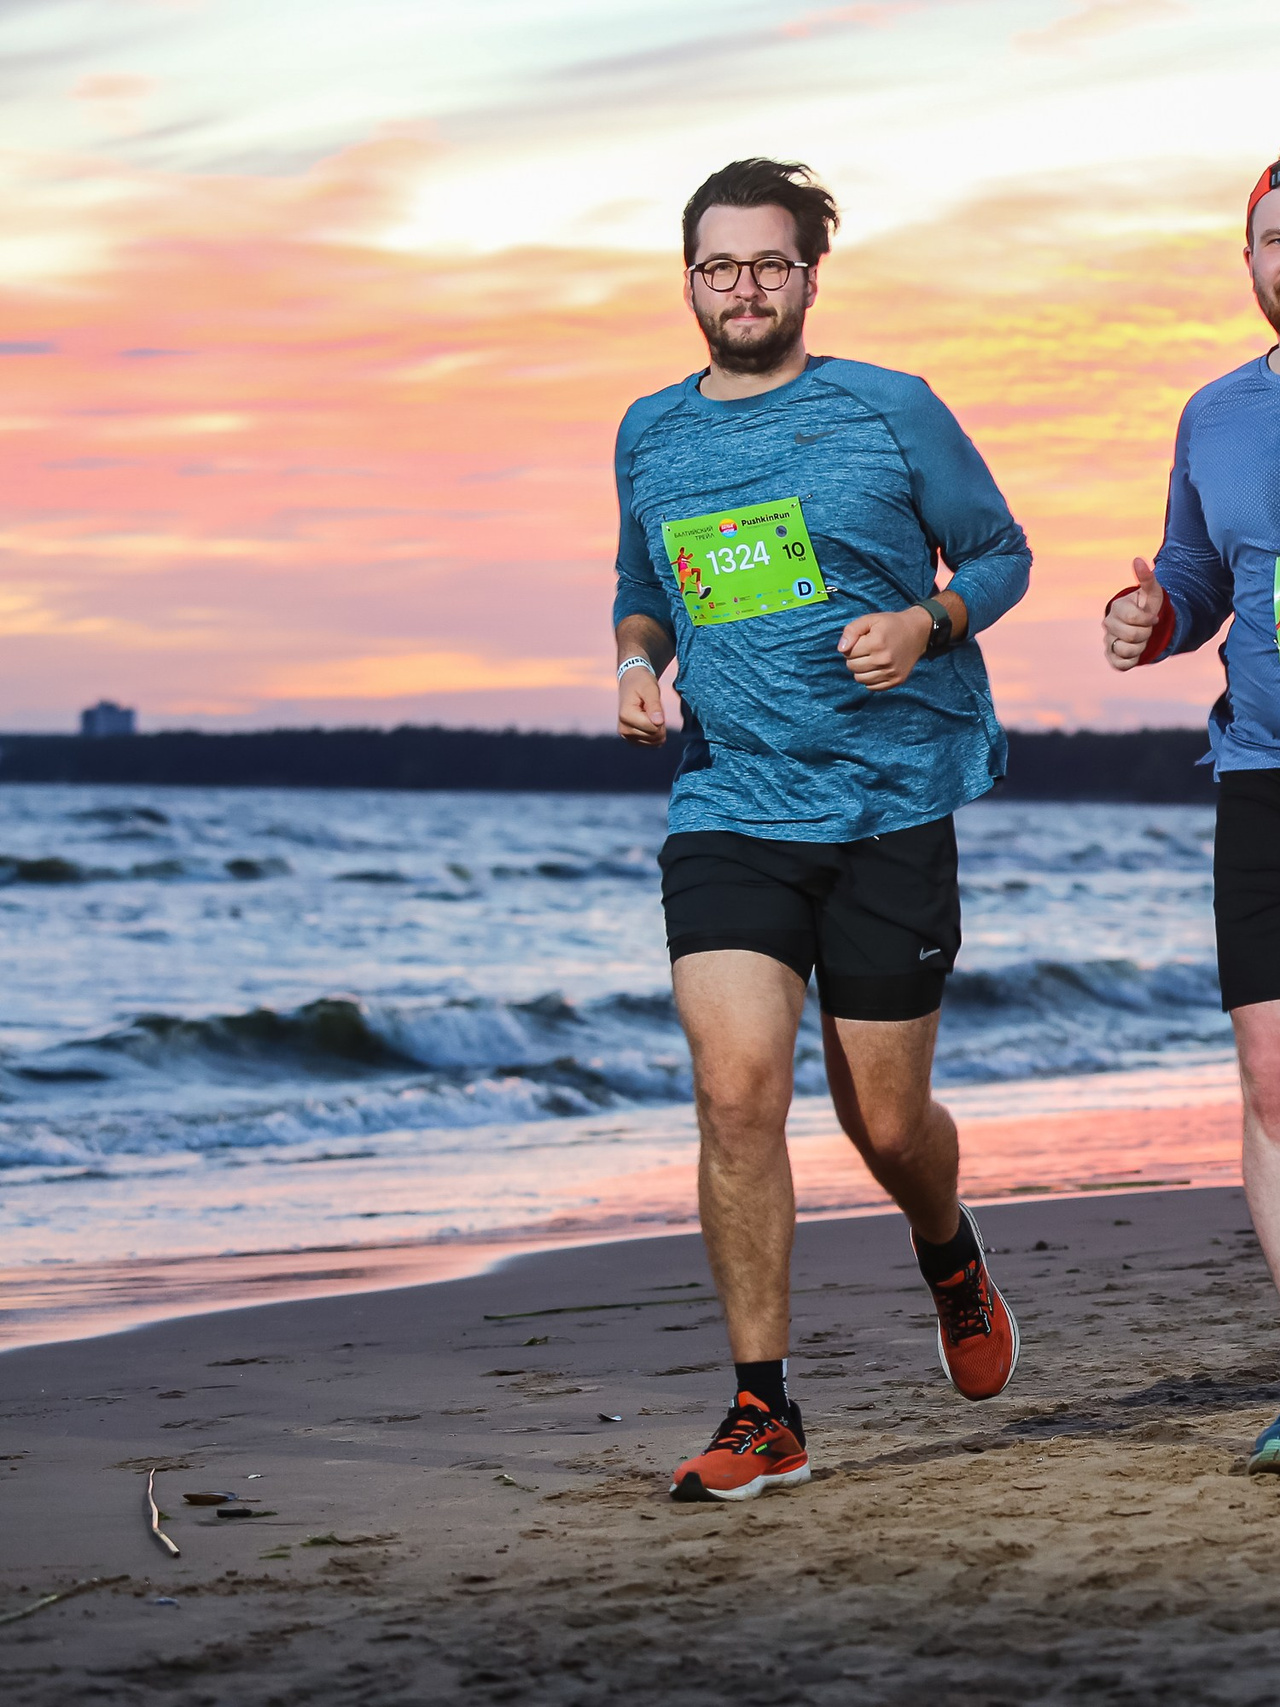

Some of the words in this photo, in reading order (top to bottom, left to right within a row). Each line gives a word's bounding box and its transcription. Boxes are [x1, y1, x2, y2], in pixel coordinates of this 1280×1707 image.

[741, 512, 790, 527] PushkinRun
[674, 526, 713, 538] БАЛТИЙСКИЙ
[705, 540, 770, 575] 1324
[782, 541, 805, 559] 10
[797, 581, 812, 596] D
